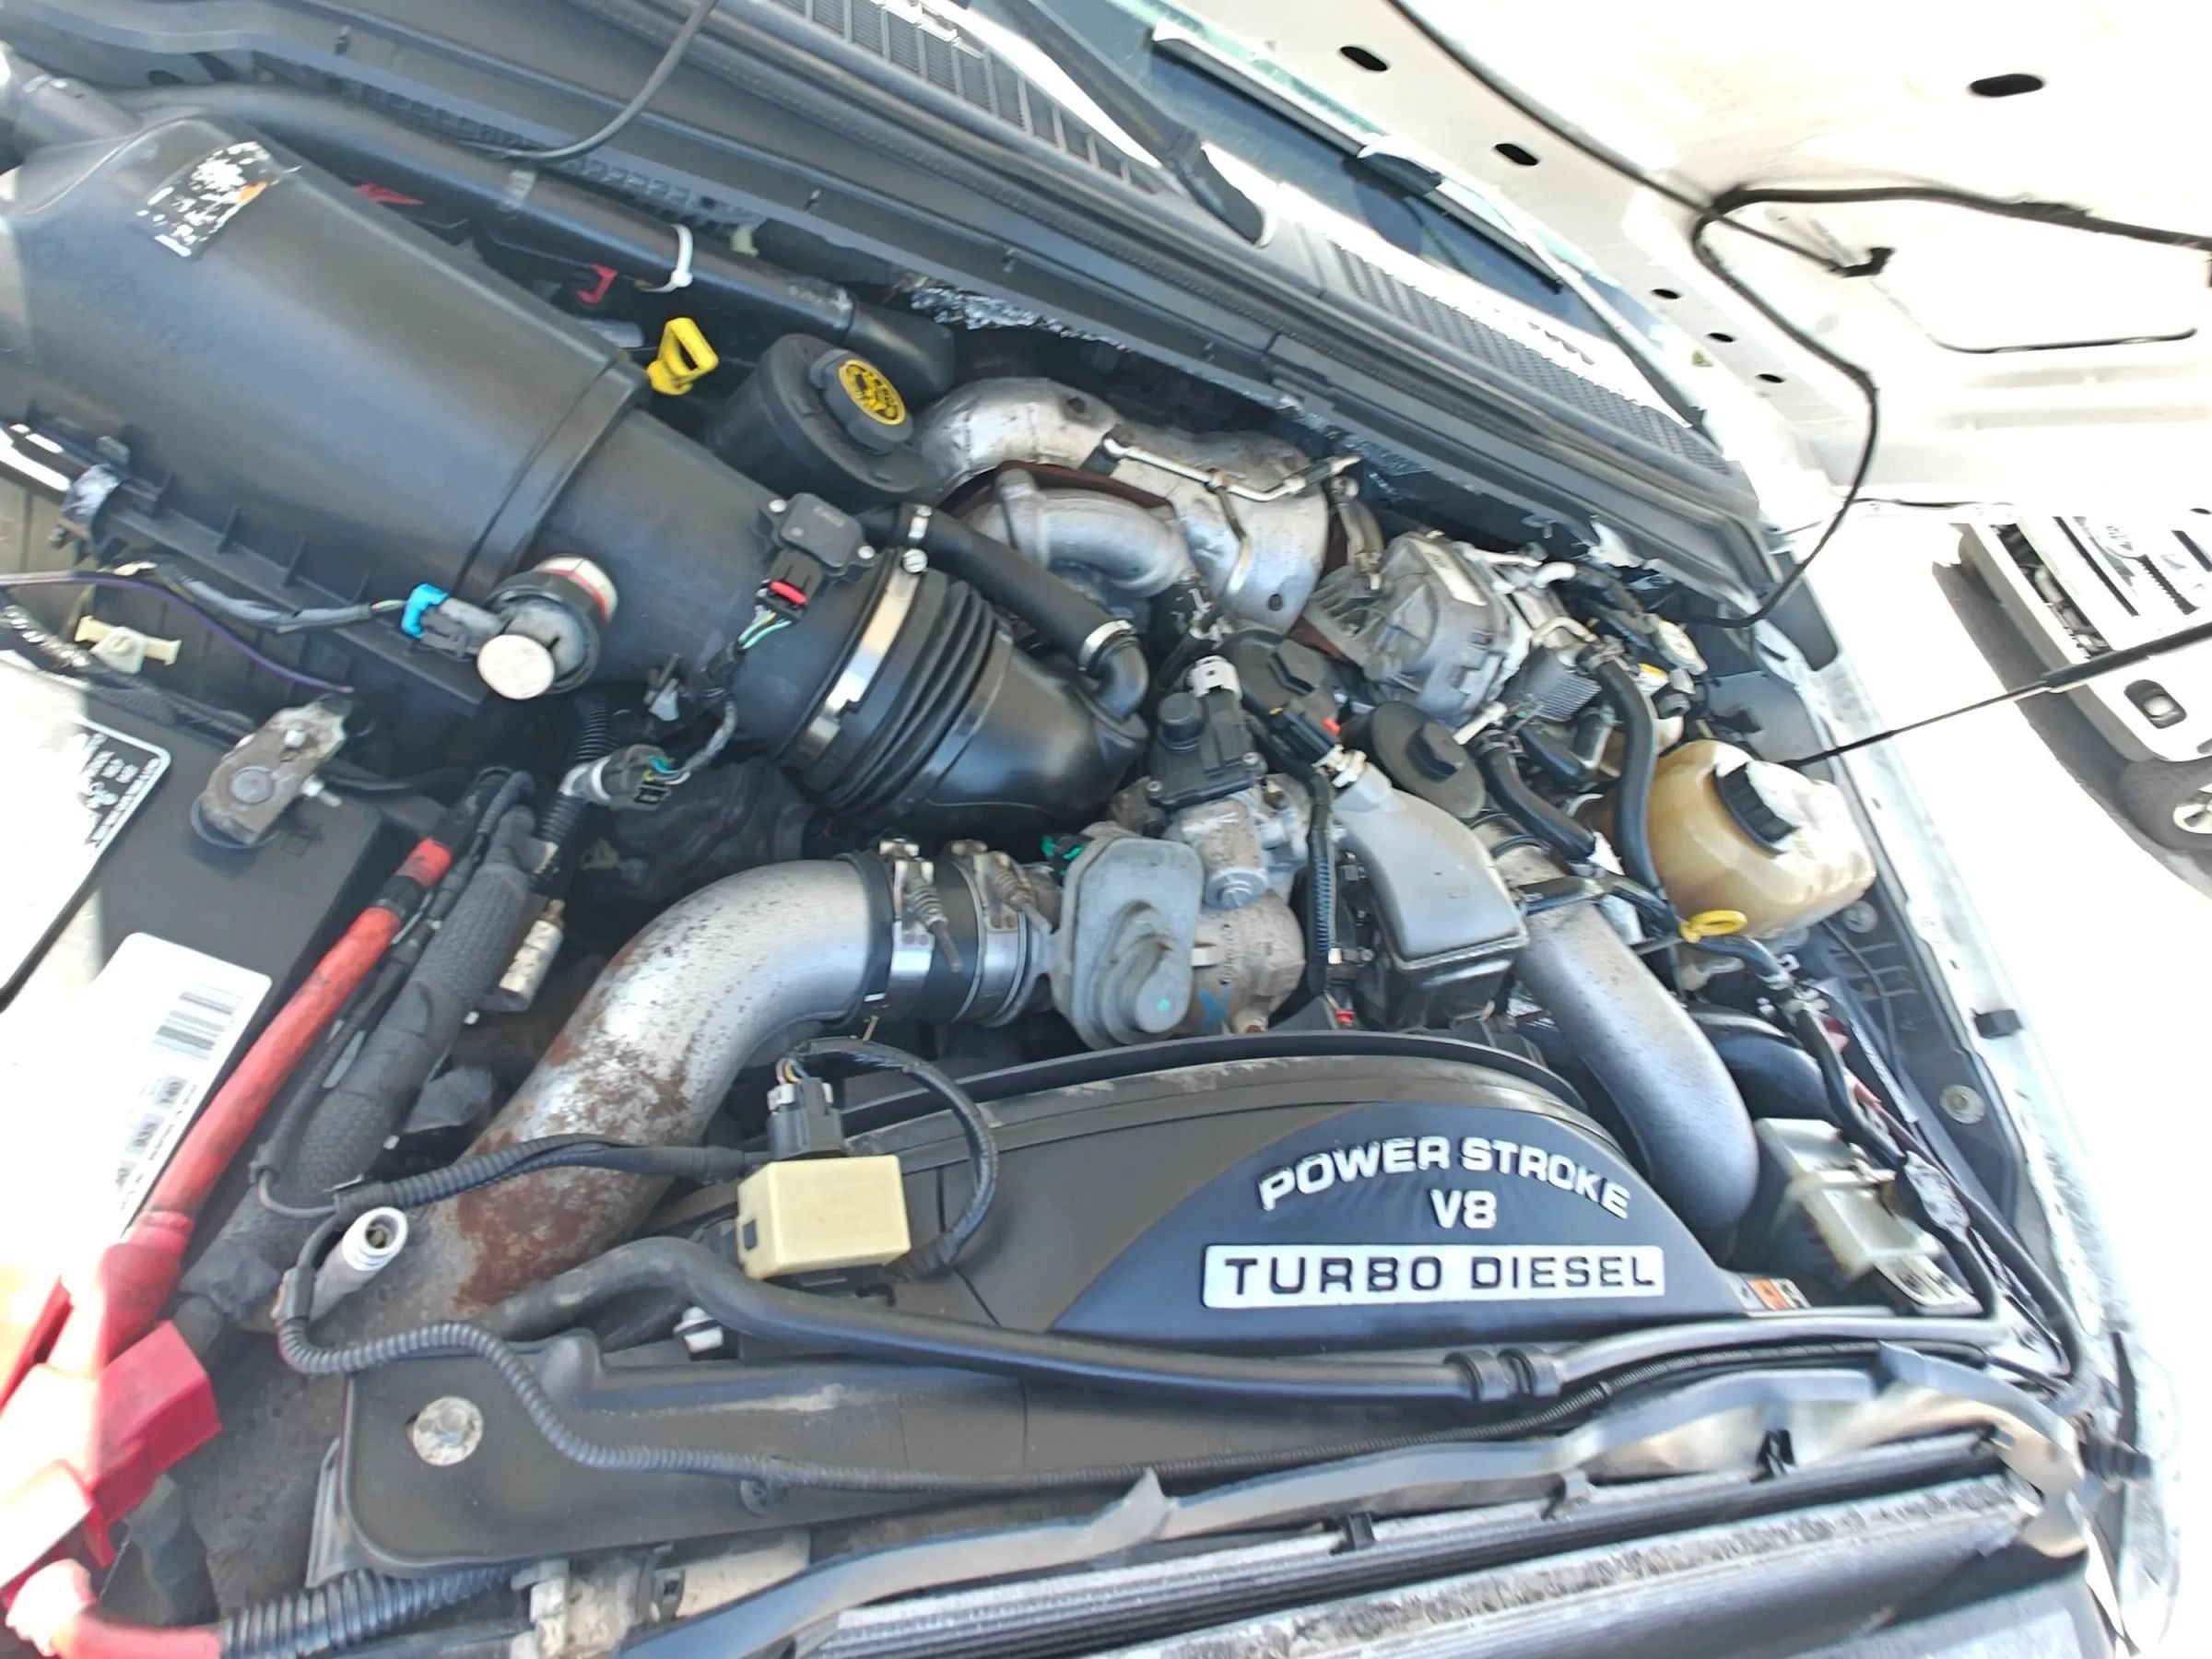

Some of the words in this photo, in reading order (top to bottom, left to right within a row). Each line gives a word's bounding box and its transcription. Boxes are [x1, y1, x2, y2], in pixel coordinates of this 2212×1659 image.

[1258, 1136, 1451, 1211] POWER
[1460, 1136, 1630, 1219] STROKE
[1430, 1189, 1498, 1230] V8
[1224, 1256, 1442, 1295] TURBO
[1470, 1256, 1656, 1289] DIESEL
